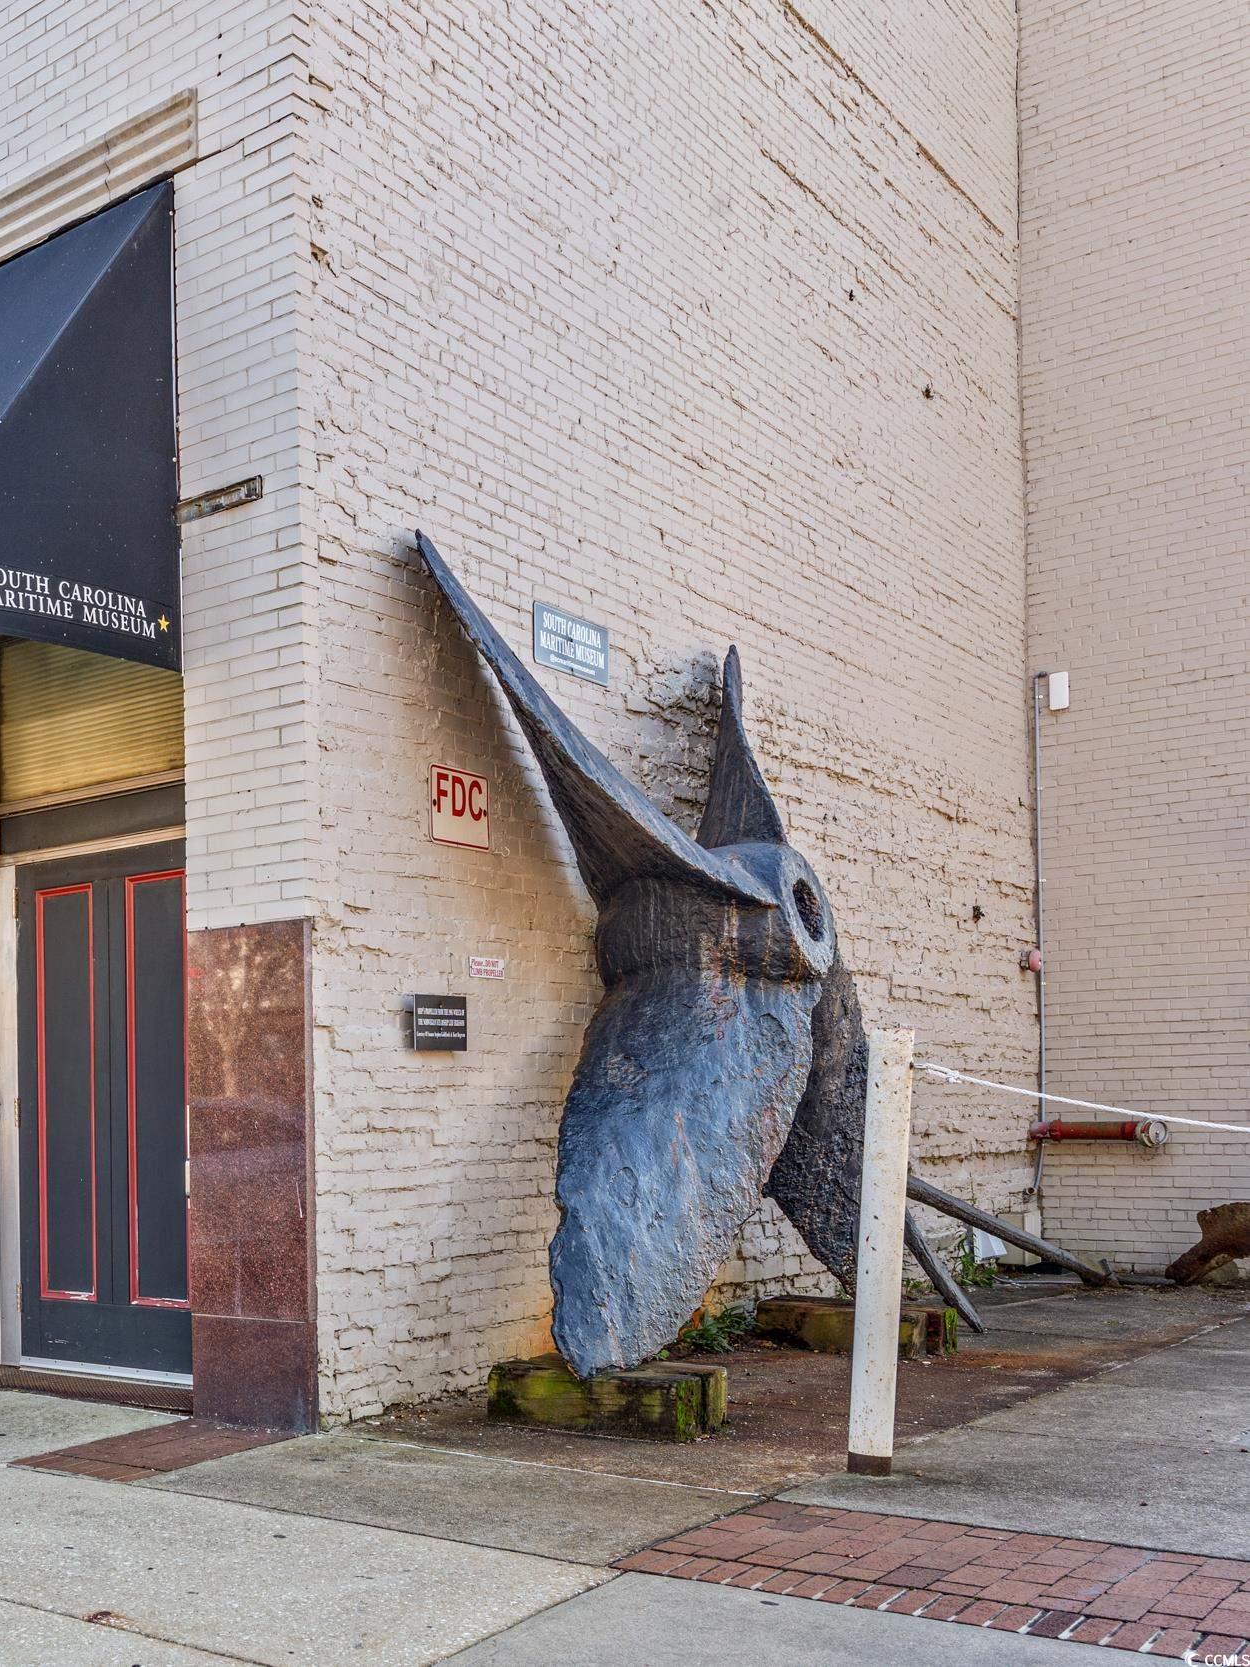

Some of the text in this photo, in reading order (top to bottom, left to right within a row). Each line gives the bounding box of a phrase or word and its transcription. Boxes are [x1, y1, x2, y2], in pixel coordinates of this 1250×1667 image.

[58, 580, 147, 618] CAROLINA
[82, 605, 156, 639] MUSEUM
[542, 611, 602, 649] SOUTH CAROLINA
[540, 630, 575, 658] MARITIME
[575, 644, 605, 670] MUSEUM
[436, 771, 483, 821] FDC
